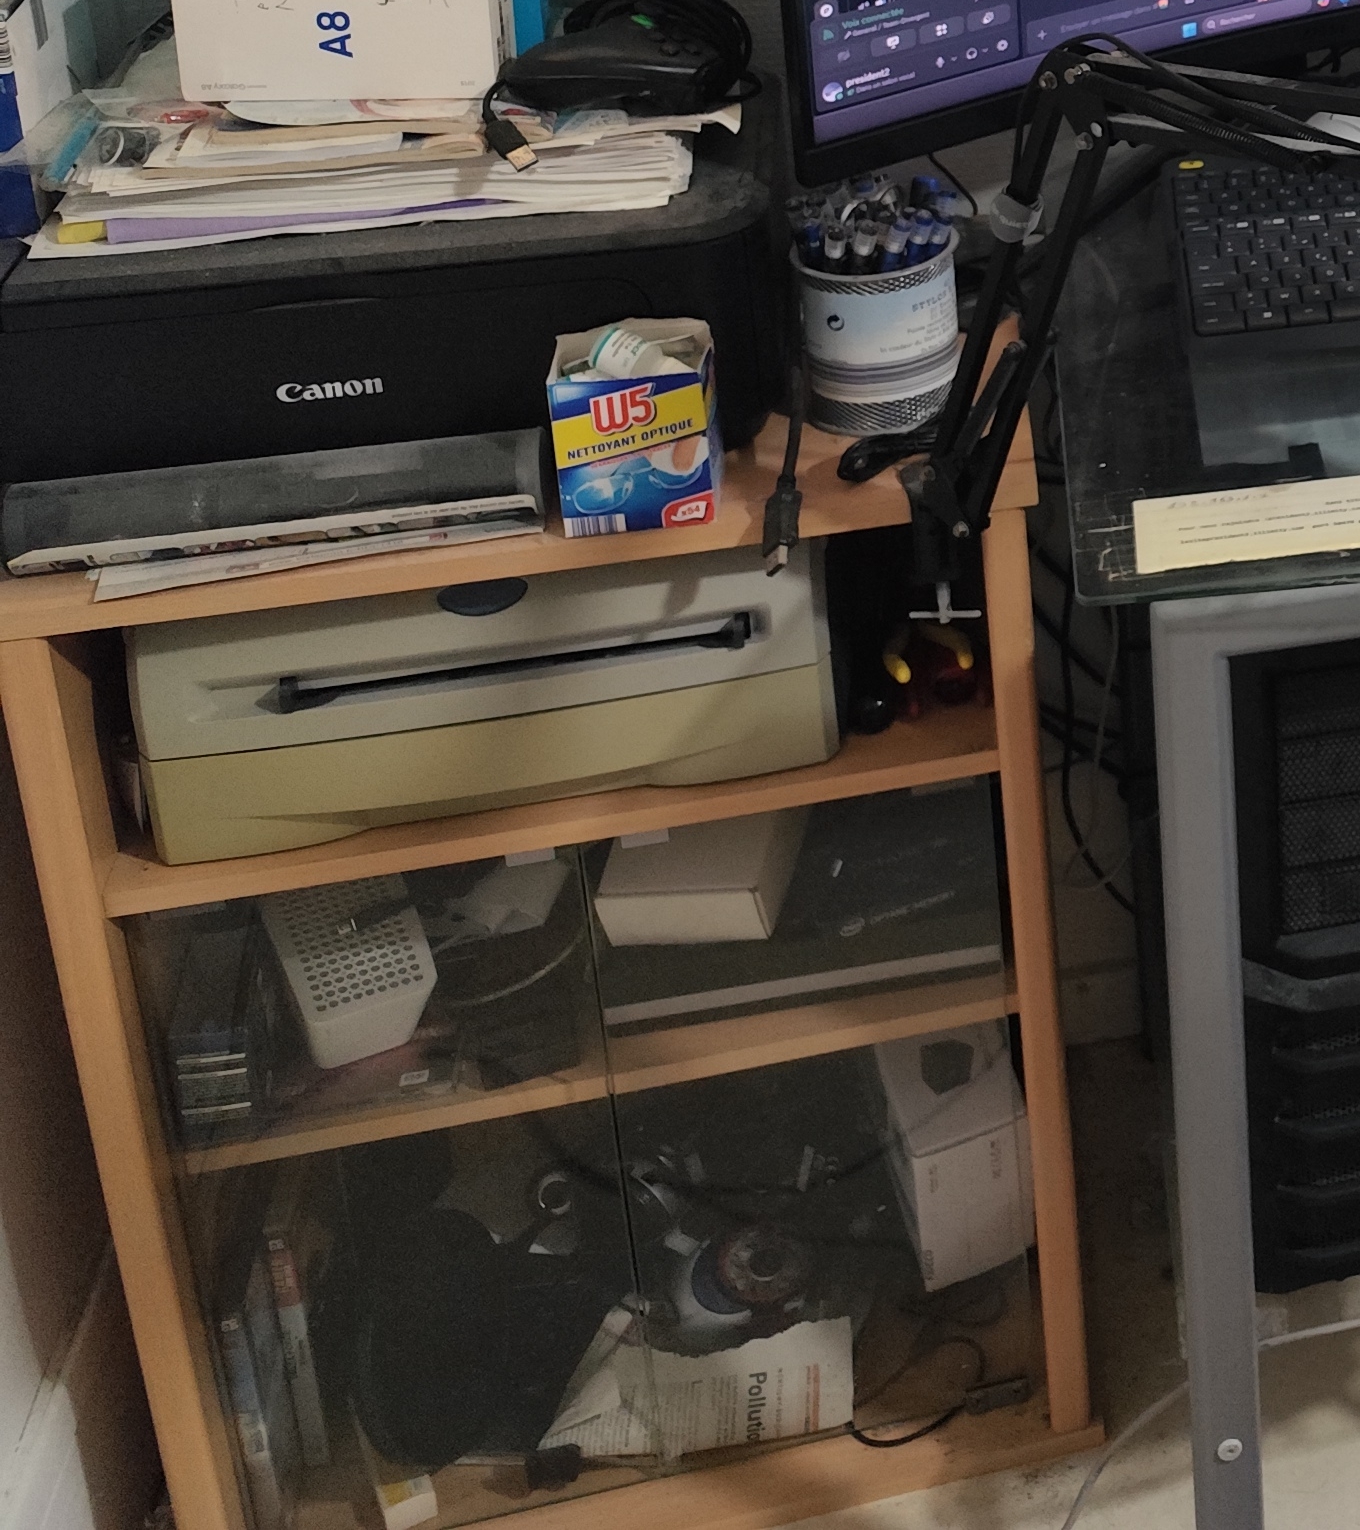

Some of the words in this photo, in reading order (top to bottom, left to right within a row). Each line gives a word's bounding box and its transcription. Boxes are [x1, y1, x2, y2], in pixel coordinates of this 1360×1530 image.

[316, 11, 354, 58] A8
[845, 67, 891, 89] president2
[276, 377, 384, 403] Canon
[590, 384, 656, 434] W5
[567, 435, 637, 460] NETTOYANT
[641, 418, 694, 441] OPTIQUE
